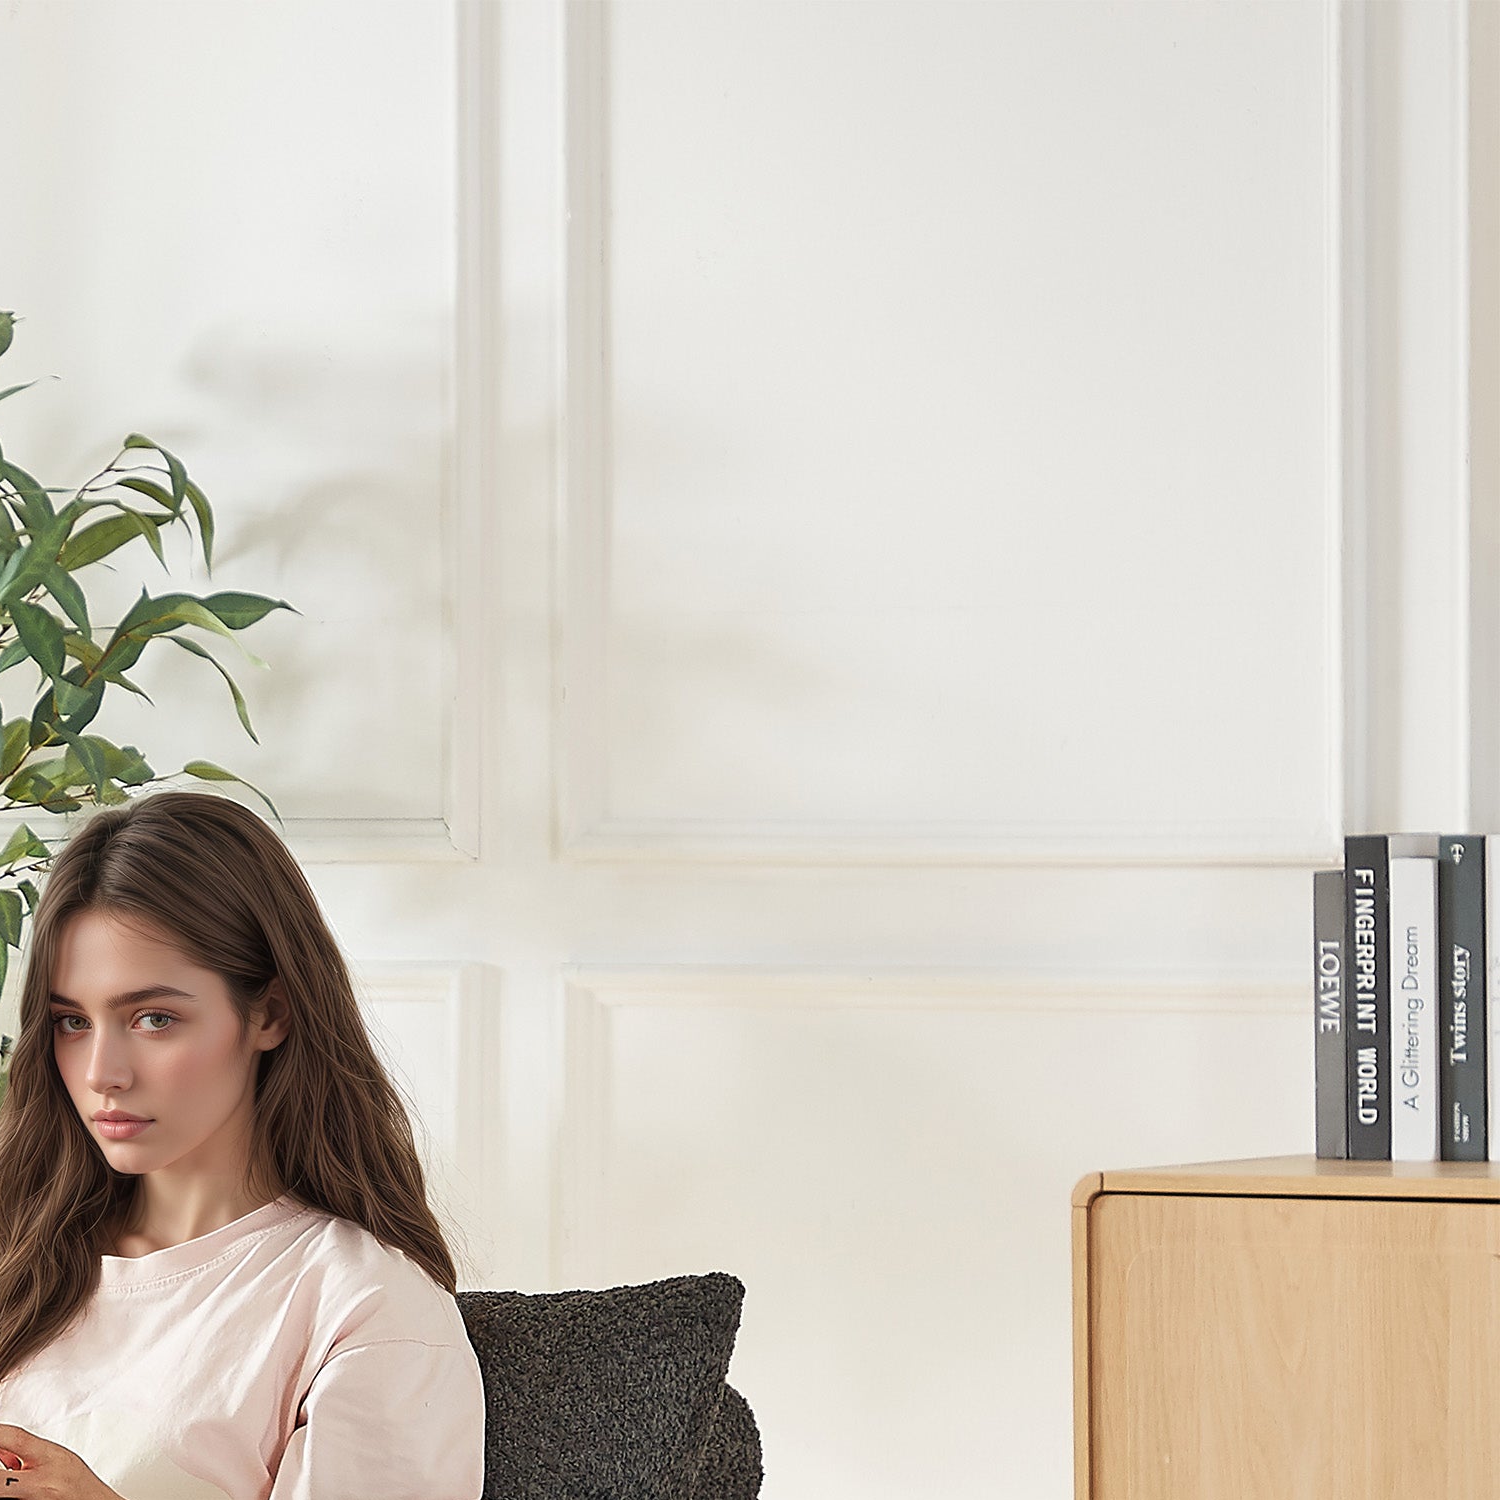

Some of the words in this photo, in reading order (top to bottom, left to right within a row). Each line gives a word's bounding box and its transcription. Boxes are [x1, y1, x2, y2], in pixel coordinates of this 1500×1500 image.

[1318, 940, 1341, 1034] LOEWE
[1354, 868, 1377, 1035] FINGERPRINT
[1402, 926, 1419, 991] Dream
[1451, 944, 1471, 1000] story
[1400, 997, 1424, 1088] Glittering
[1450, 1001, 1468, 1067] Twins
[1357, 1047, 1378, 1126] WORLD
[1403, 1094, 1420, 1111] A
